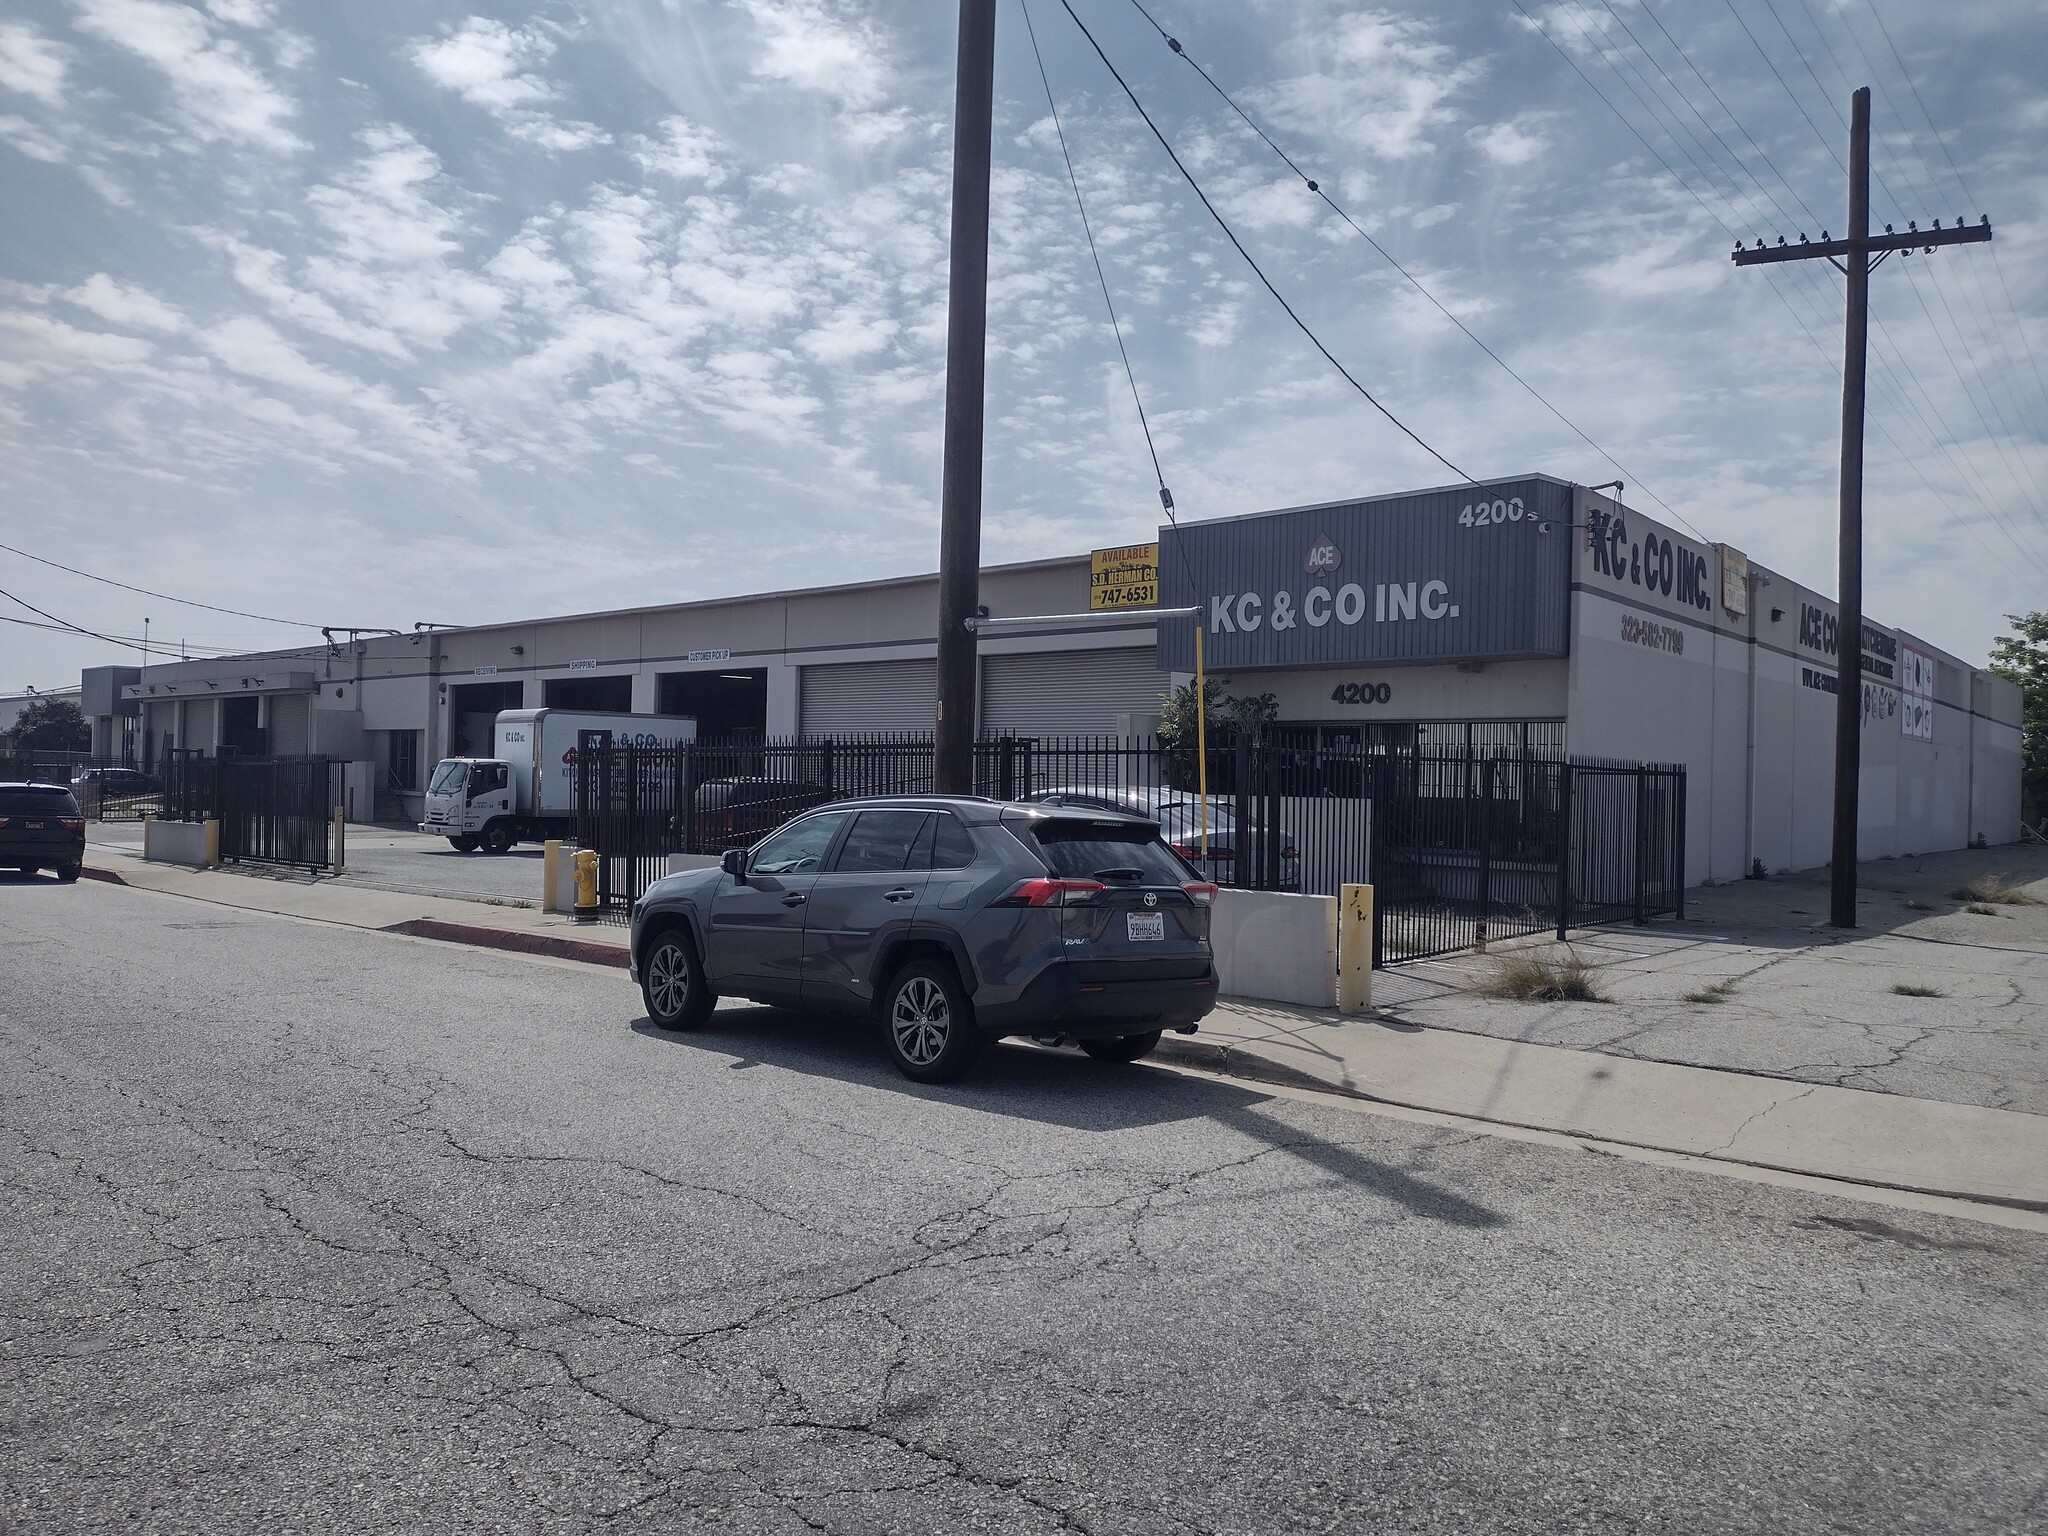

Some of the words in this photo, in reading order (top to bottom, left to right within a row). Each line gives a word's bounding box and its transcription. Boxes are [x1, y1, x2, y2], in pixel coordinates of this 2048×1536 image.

[1458, 497, 1524, 528] 4200
[1101, 546, 1150, 563] AVAILABLE
[1308, 545, 1334, 566] ACE
[1593, 509, 1628, 581] KC
[1630, 542, 1641, 586] &
[1644, 532, 1674, 597] CO
[1676, 545, 1711, 611] INC.
[1108, 568, 1143, 585] HERMAN
[1143, 567, 1158, 581] CO.
[1101, 585, 1154, 605] 747-6531
[1210, 592, 1263, 634] KC
[1270, 590, 1298, 632] &
[1304, 583, 1366, 627] CO
[1375, 579, 1461, 623] INC.
[1800, 602, 1822, 652] ACE
[571, 660, 595, 671] SHIPPING
[690, 651, 711, 662] CUSTOMER
[1331, 682, 1391, 705] 4200
